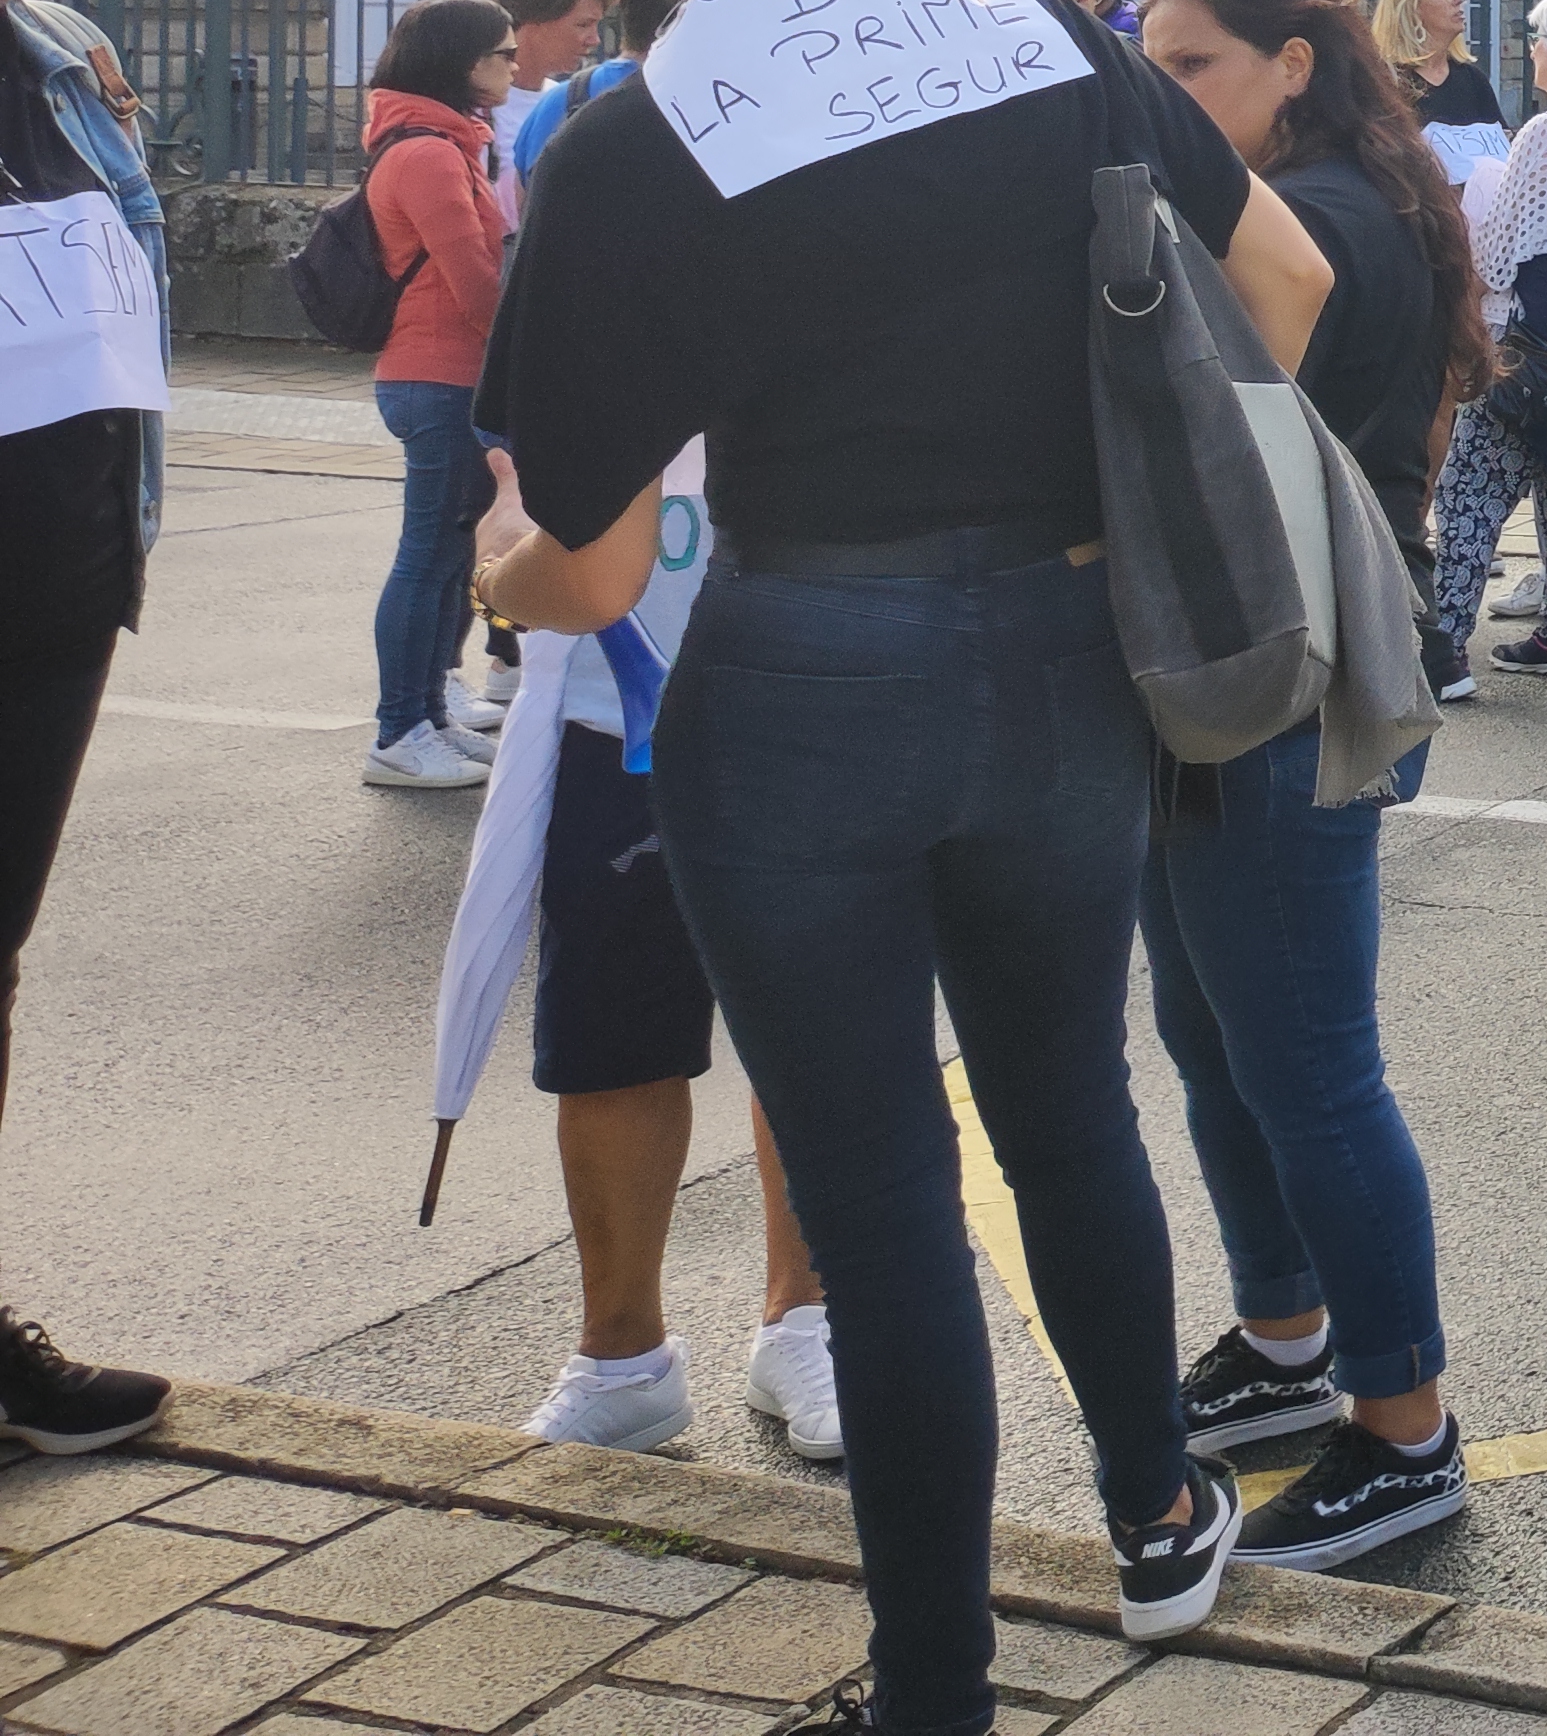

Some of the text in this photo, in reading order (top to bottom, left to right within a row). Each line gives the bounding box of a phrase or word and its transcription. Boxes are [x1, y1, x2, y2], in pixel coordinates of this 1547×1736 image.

[670, 78, 761, 144] LA
[824, 40, 1056, 141] SEGUR
[0, 218, 154, 327] TSEM
[1140, 1535, 1176, 1559] NIKE
